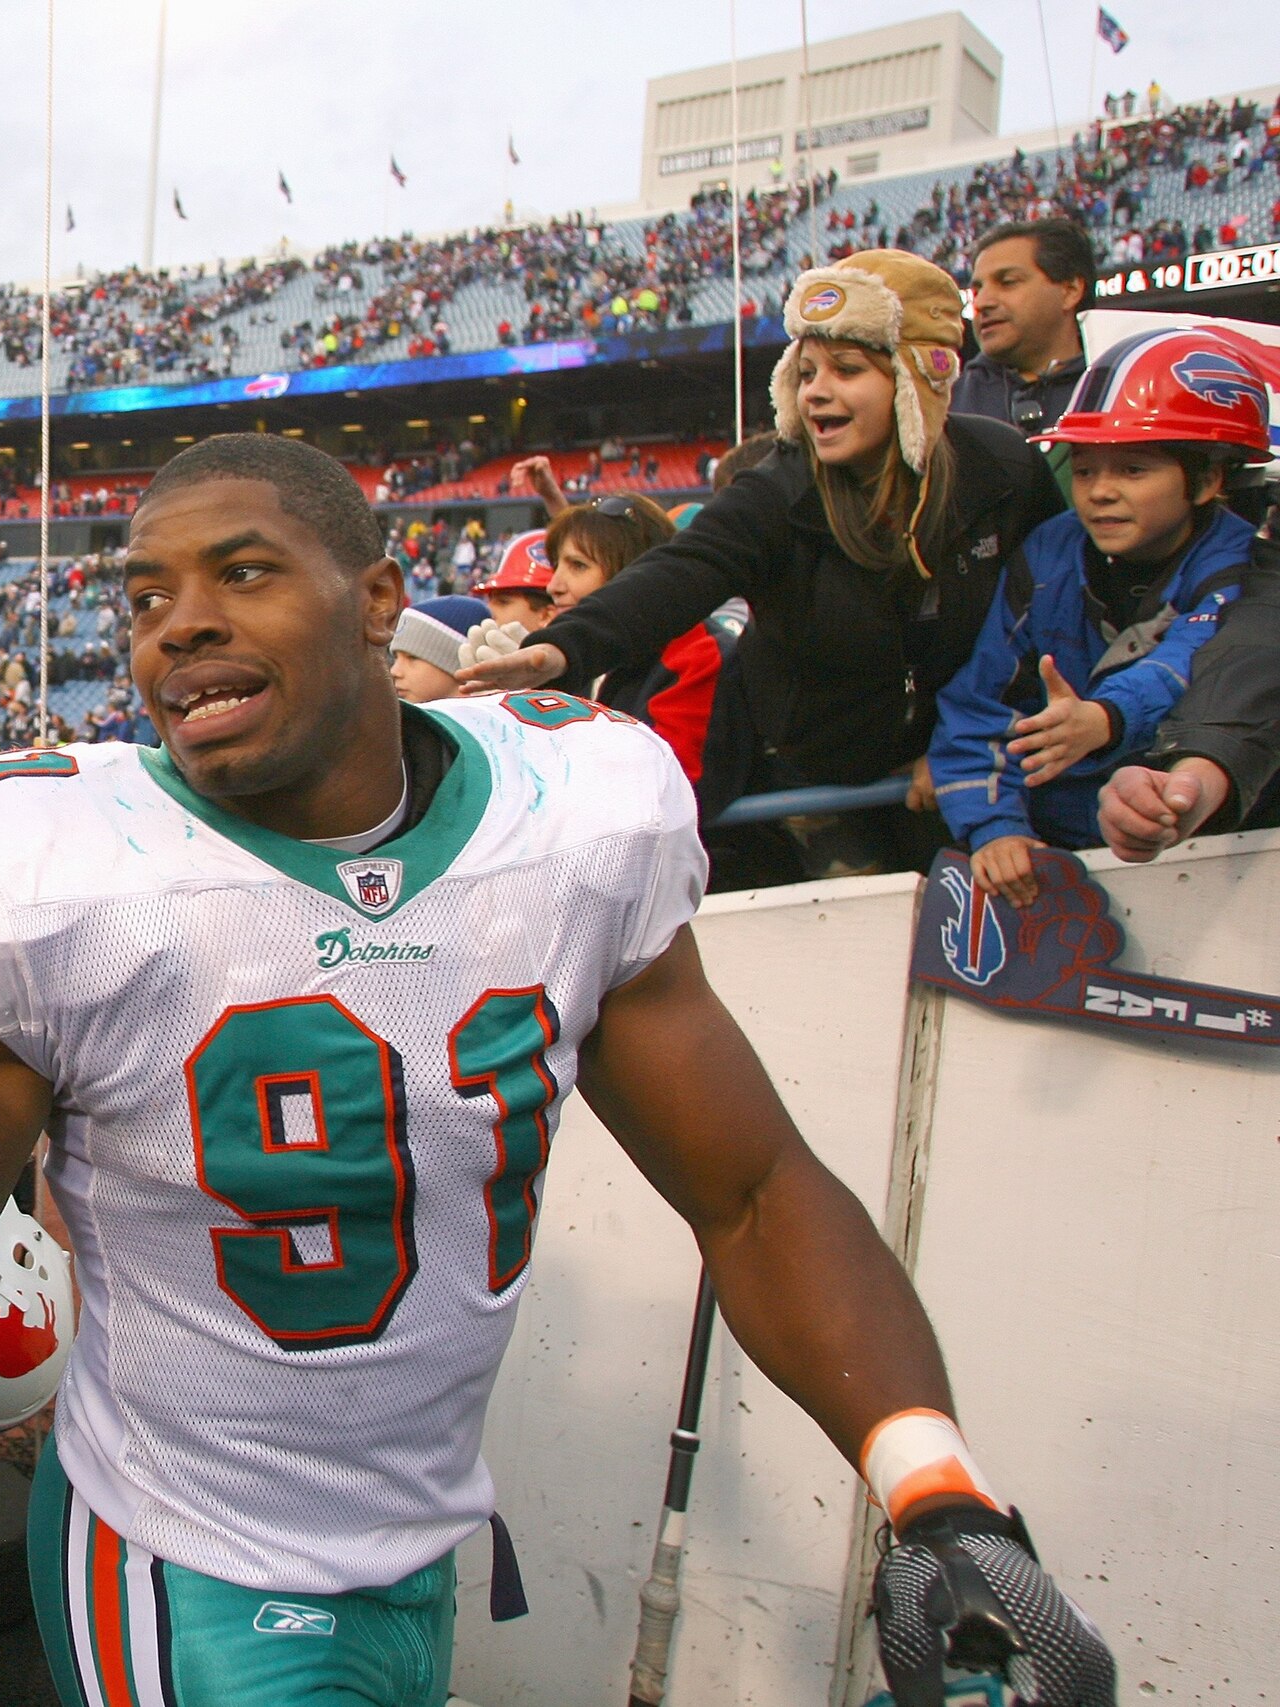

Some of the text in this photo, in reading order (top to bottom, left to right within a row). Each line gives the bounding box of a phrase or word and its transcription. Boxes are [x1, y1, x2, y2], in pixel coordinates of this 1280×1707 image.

[1095, 272, 1124, 297] nd
[1126, 269, 1149, 292] &
[1152, 264, 1183, 289] 10
[343, 863, 396, 876] EQUIPMENT
[361, 886, 388, 903] NFL
[315, 927, 434, 968] Dolphins
[1085, 985, 1188, 1022] FAN
[183, 981, 561, 1352] 91
